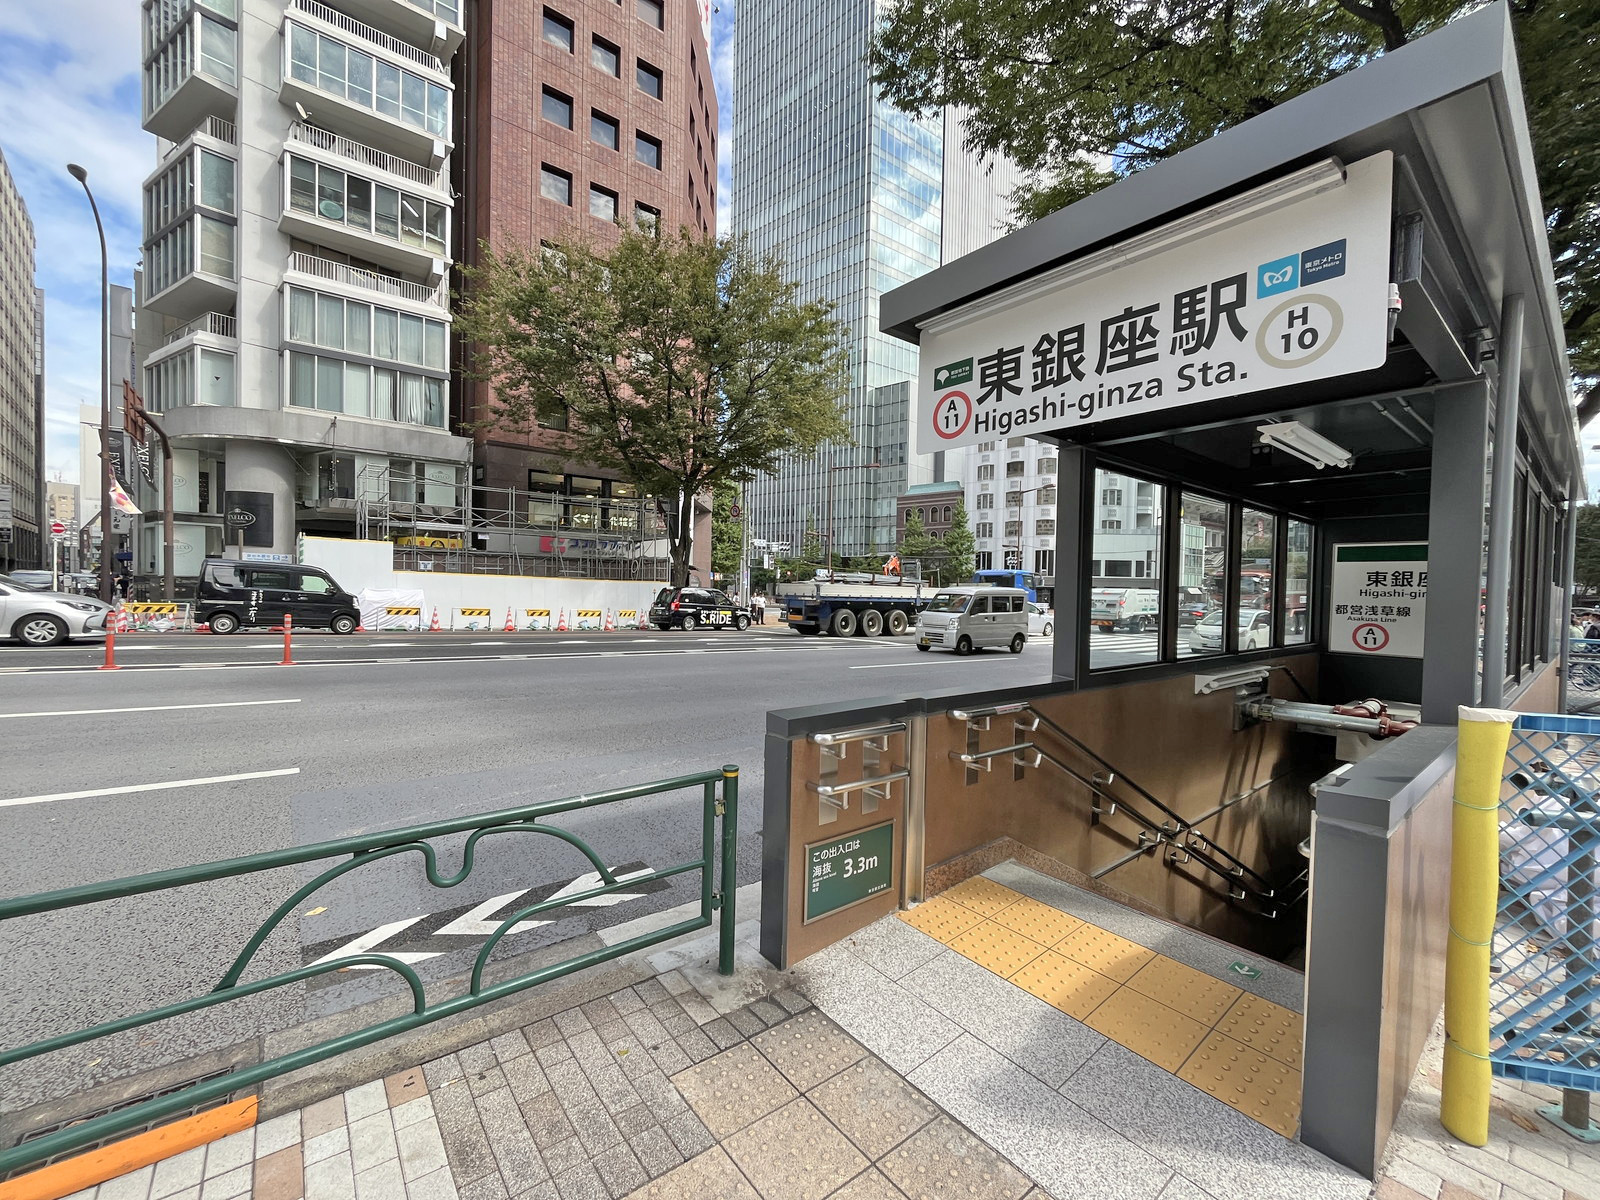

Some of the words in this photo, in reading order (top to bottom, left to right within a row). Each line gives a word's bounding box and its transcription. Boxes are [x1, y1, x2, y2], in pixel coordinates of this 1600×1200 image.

[1305, 252, 1342, 269] 東京メトロ
[1307, 265, 1322, 273] Tokyo
[1323, 260, 1340, 269] Metro
[1288, 306, 1308, 329] H
[976, 272, 1248, 406] 東銀座駅
[1281, 327, 1319, 354] 10
[975, 376, 1163, 435] Higashi-ginza
[1178, 360, 1248, 392] Sta.
[946, 399, 957, 413] A
[944, 413, 959, 429] 11
[700, 613, 732, 624] S.RIDE
[1336, 605, 1411, 617] 都営浅草線
[1347, 615, 1378, 623] Asakusa
[1365, 628, 1375, 636] A
[1363, 636, 1377, 645] 11
[813, 840, 860, 862] この出入口は
[813, 862, 832, 878] 海抜
[843, 855, 878, 878] 3.3m
